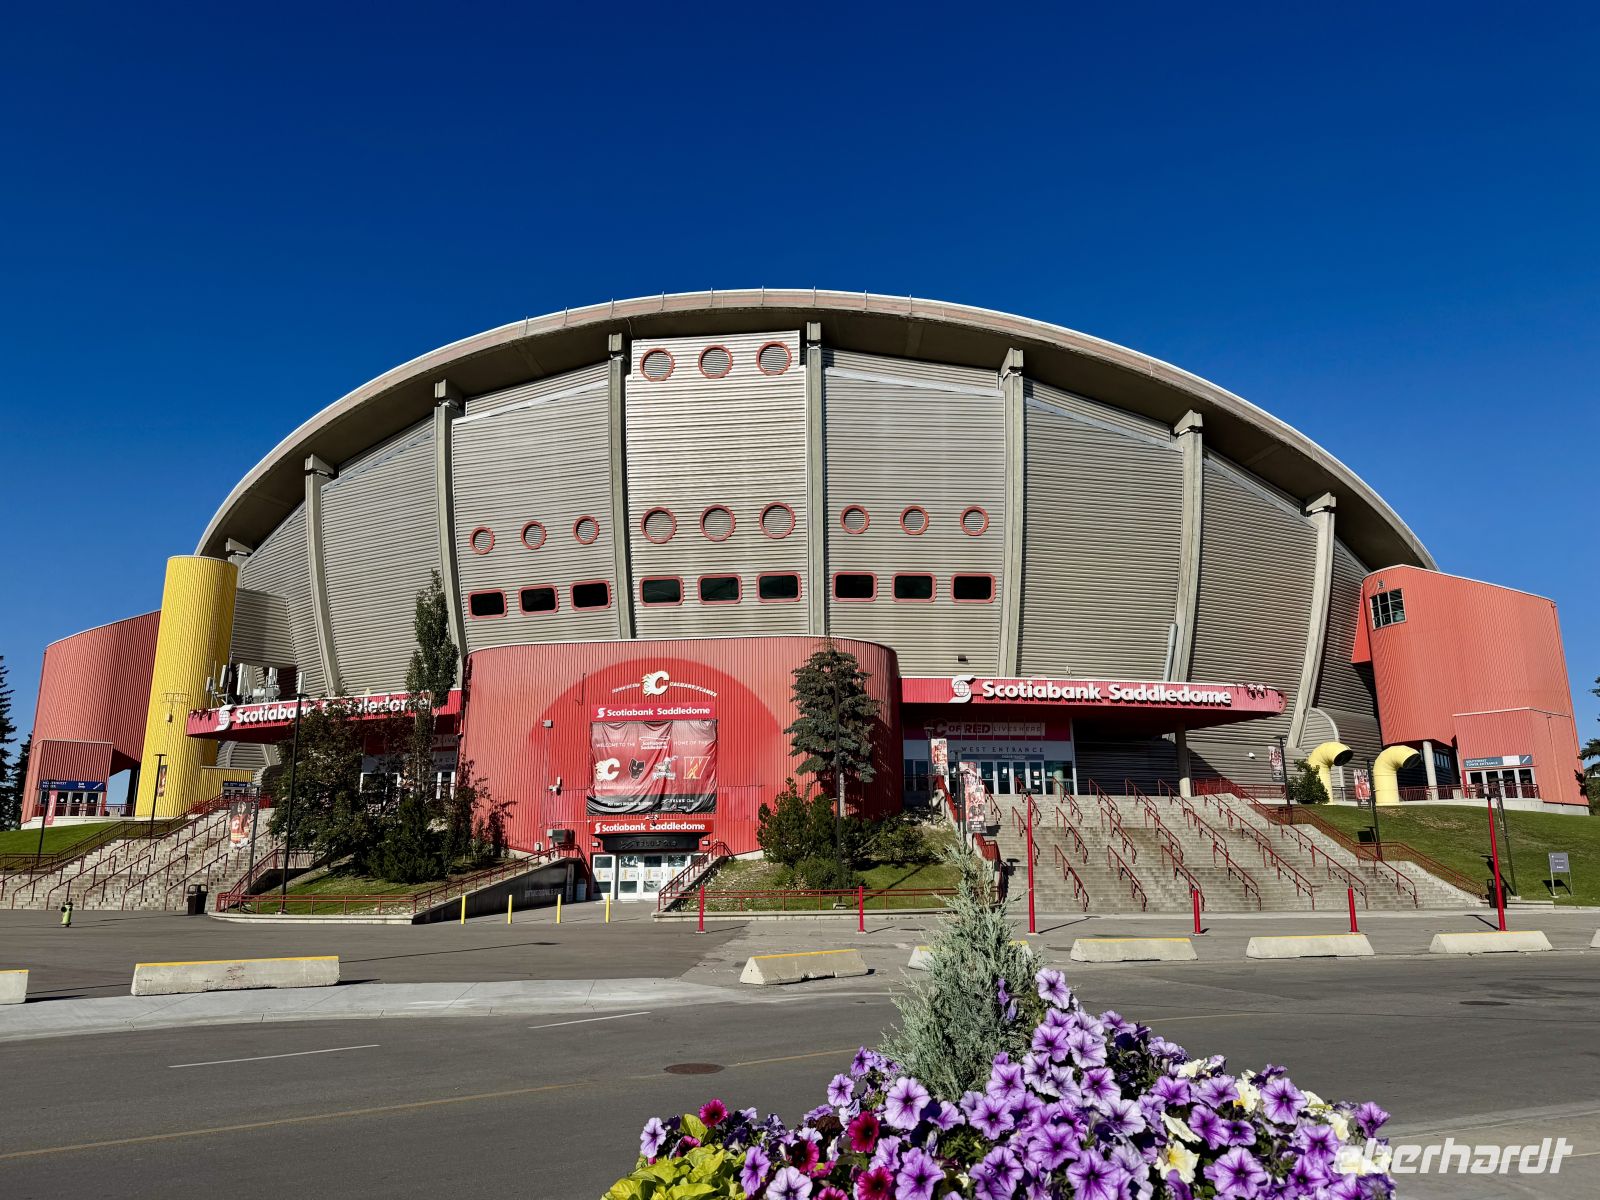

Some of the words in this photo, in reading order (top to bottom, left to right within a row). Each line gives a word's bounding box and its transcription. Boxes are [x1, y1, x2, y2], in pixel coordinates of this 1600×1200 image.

[981, 680, 1101, 701] Scotiabank
[1107, 684, 1232, 706] Saddledome
[607, 707, 654, 717] Scotiabank
[657, 706, 711, 716] Saddledome
[964, 723, 991, 734] RED
[602, 822, 646, 832] Scotiabank
[649, 822, 706, 831] Saddledome
